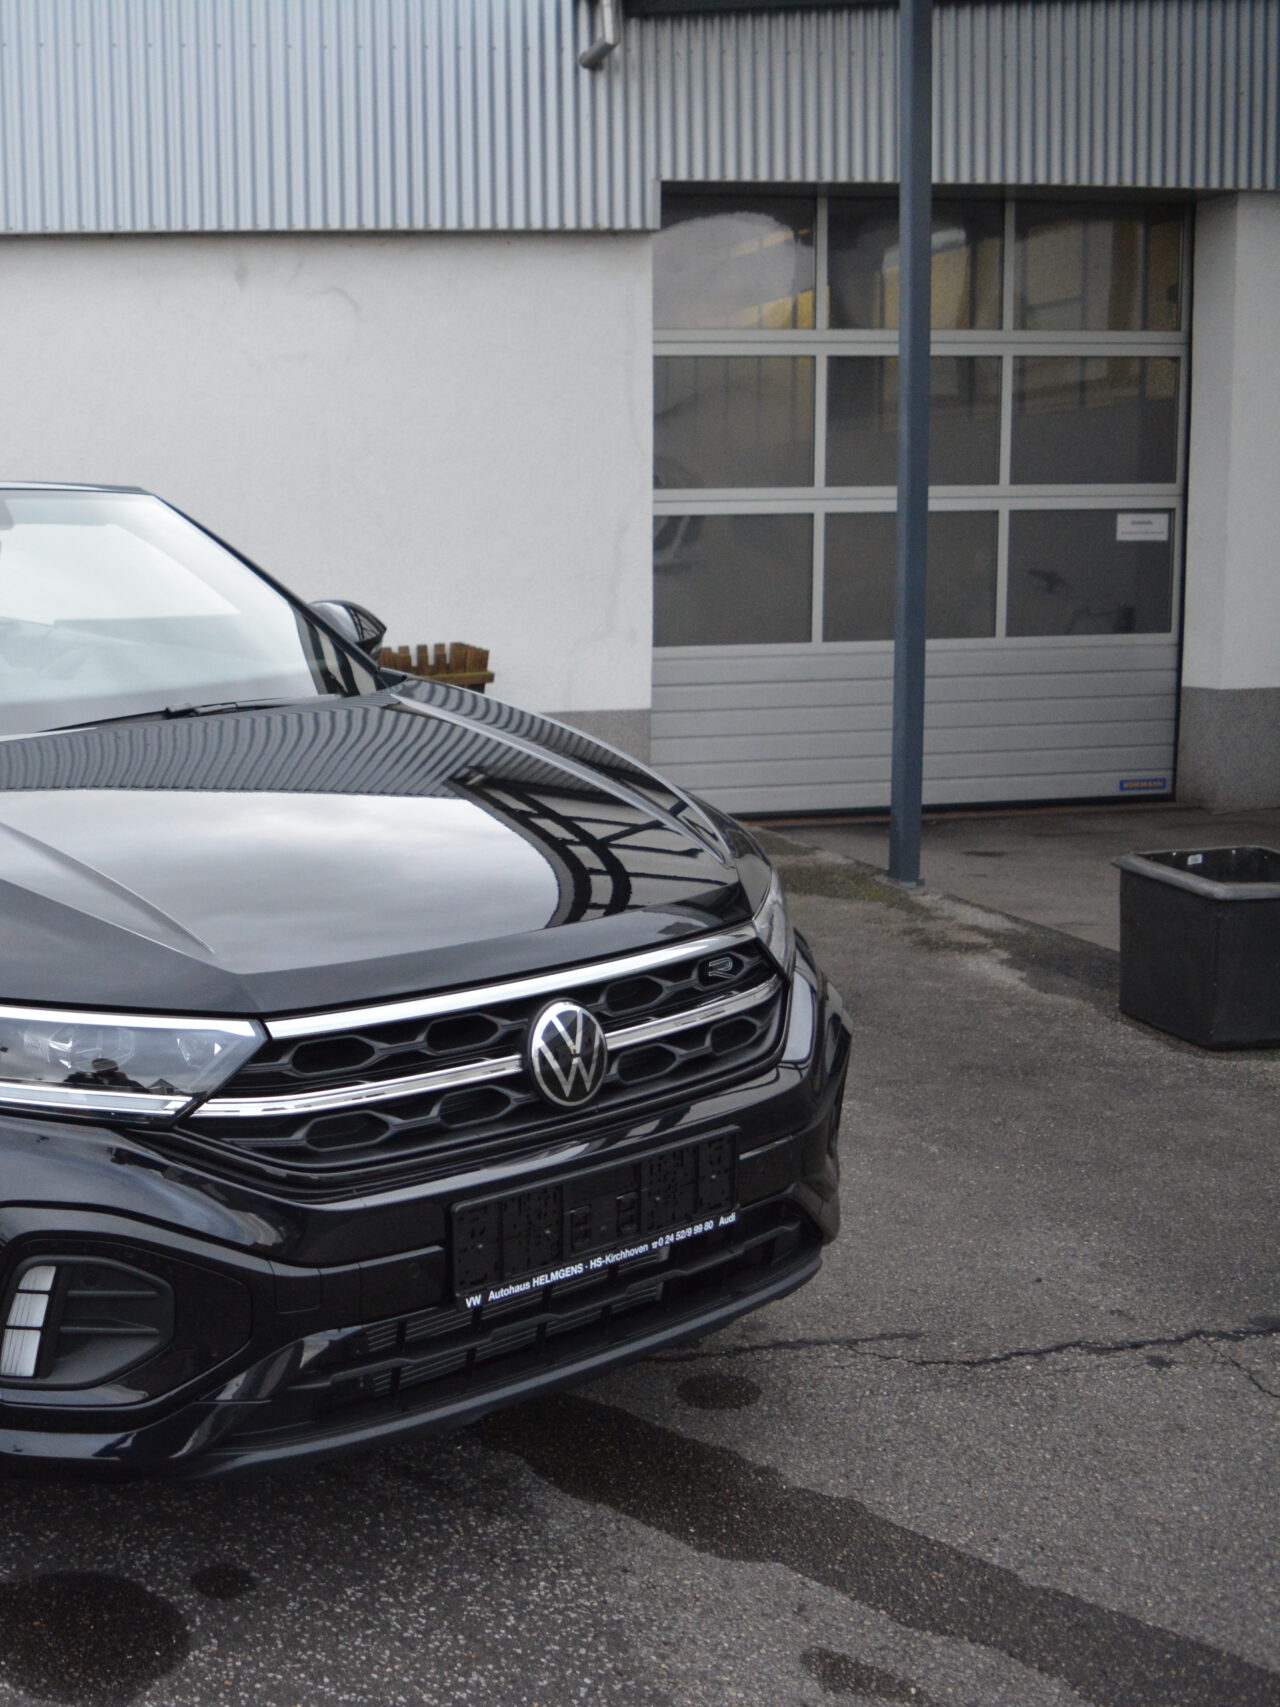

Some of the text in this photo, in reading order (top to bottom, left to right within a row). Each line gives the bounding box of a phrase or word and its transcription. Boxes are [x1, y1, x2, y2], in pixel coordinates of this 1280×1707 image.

[465, 1294, 482, 1309] VW
[488, 1281, 531, 1302] Autohaus
[532, 1262, 584, 1288] HELMGENS
[589, 1244, 648, 1270] HS-Kirchhoven
[718, 1211, 736, 1227] Audi
